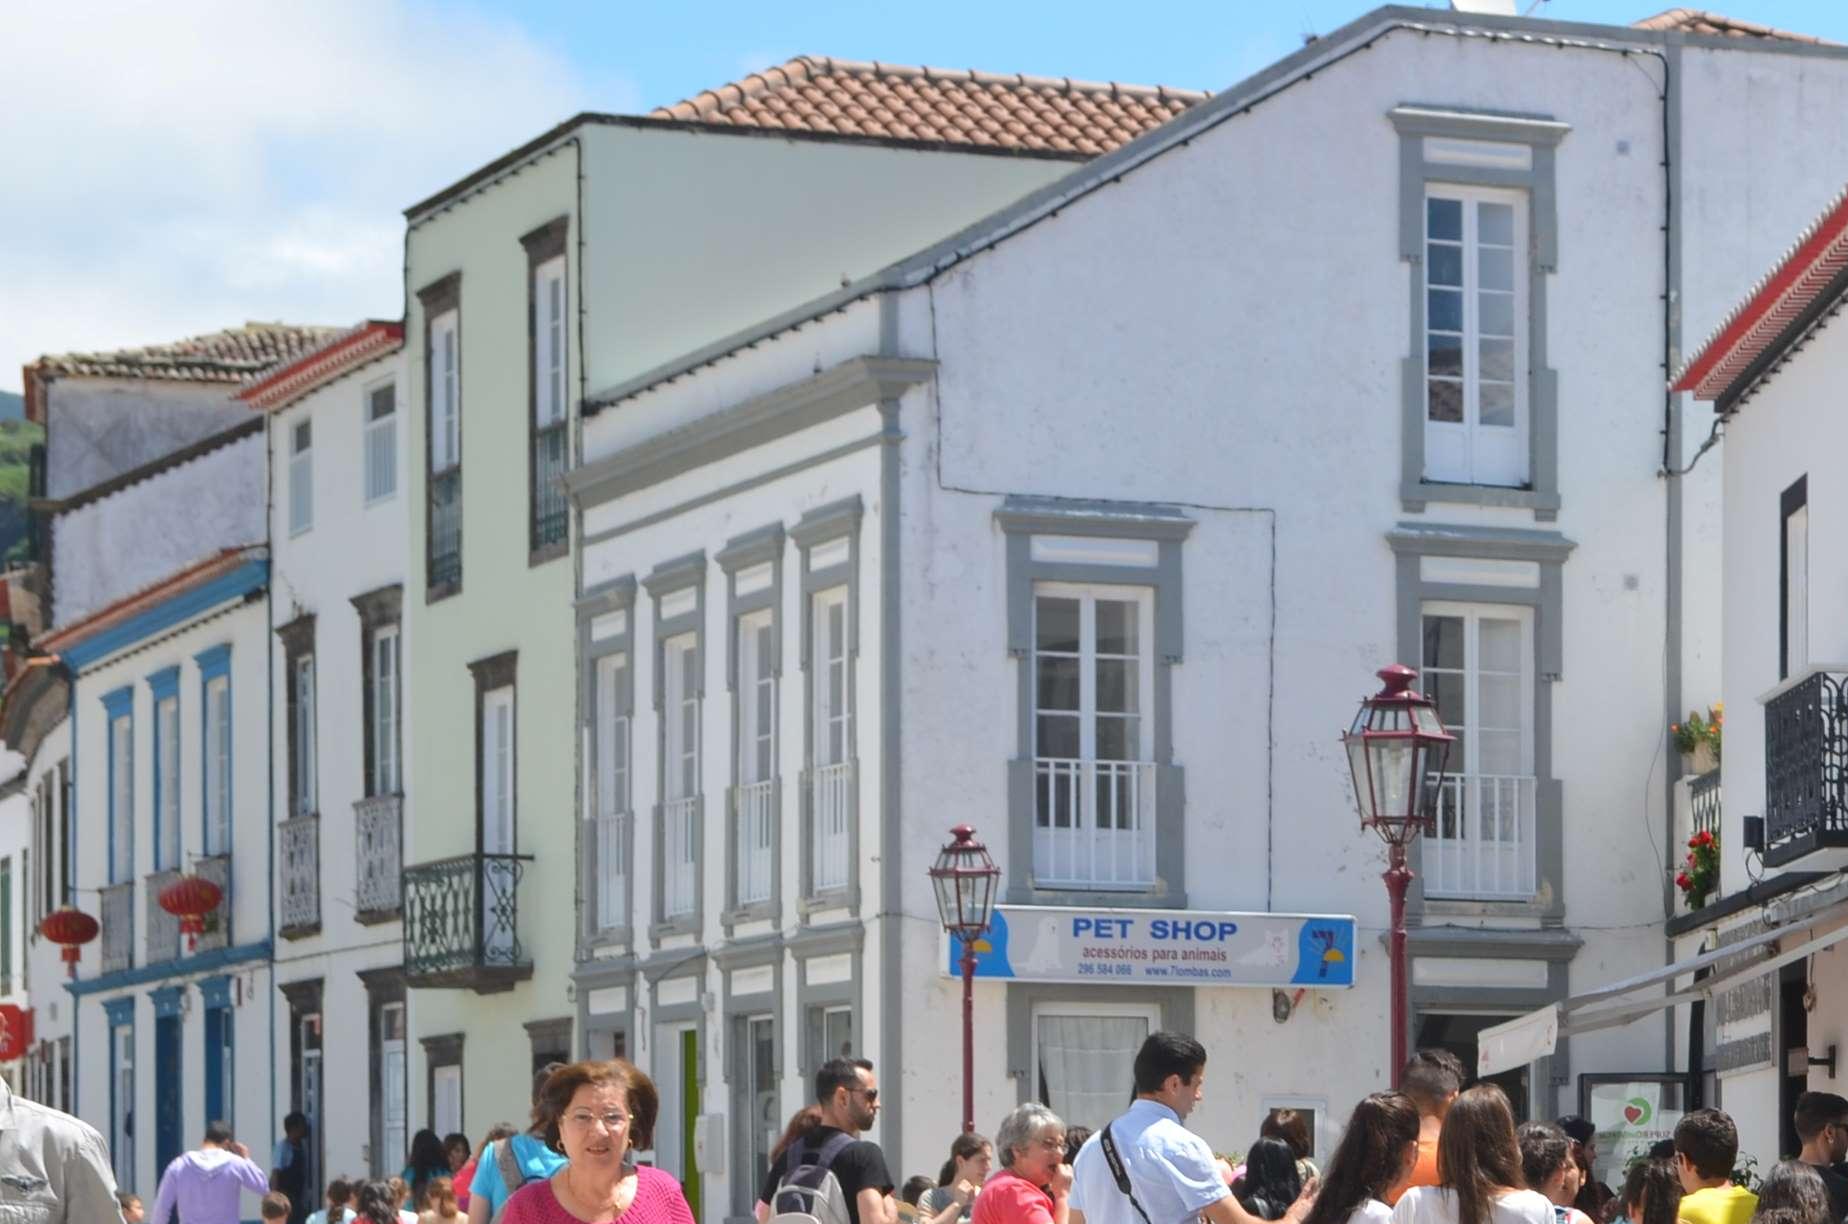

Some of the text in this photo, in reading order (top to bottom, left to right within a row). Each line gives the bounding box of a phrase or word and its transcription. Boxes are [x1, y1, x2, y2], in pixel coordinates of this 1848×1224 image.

[1072, 918, 1238, 941] PET SHOP
[1083, 945, 1227, 963] acessórios para animais
[1077, 963, 1095, 975] 296
